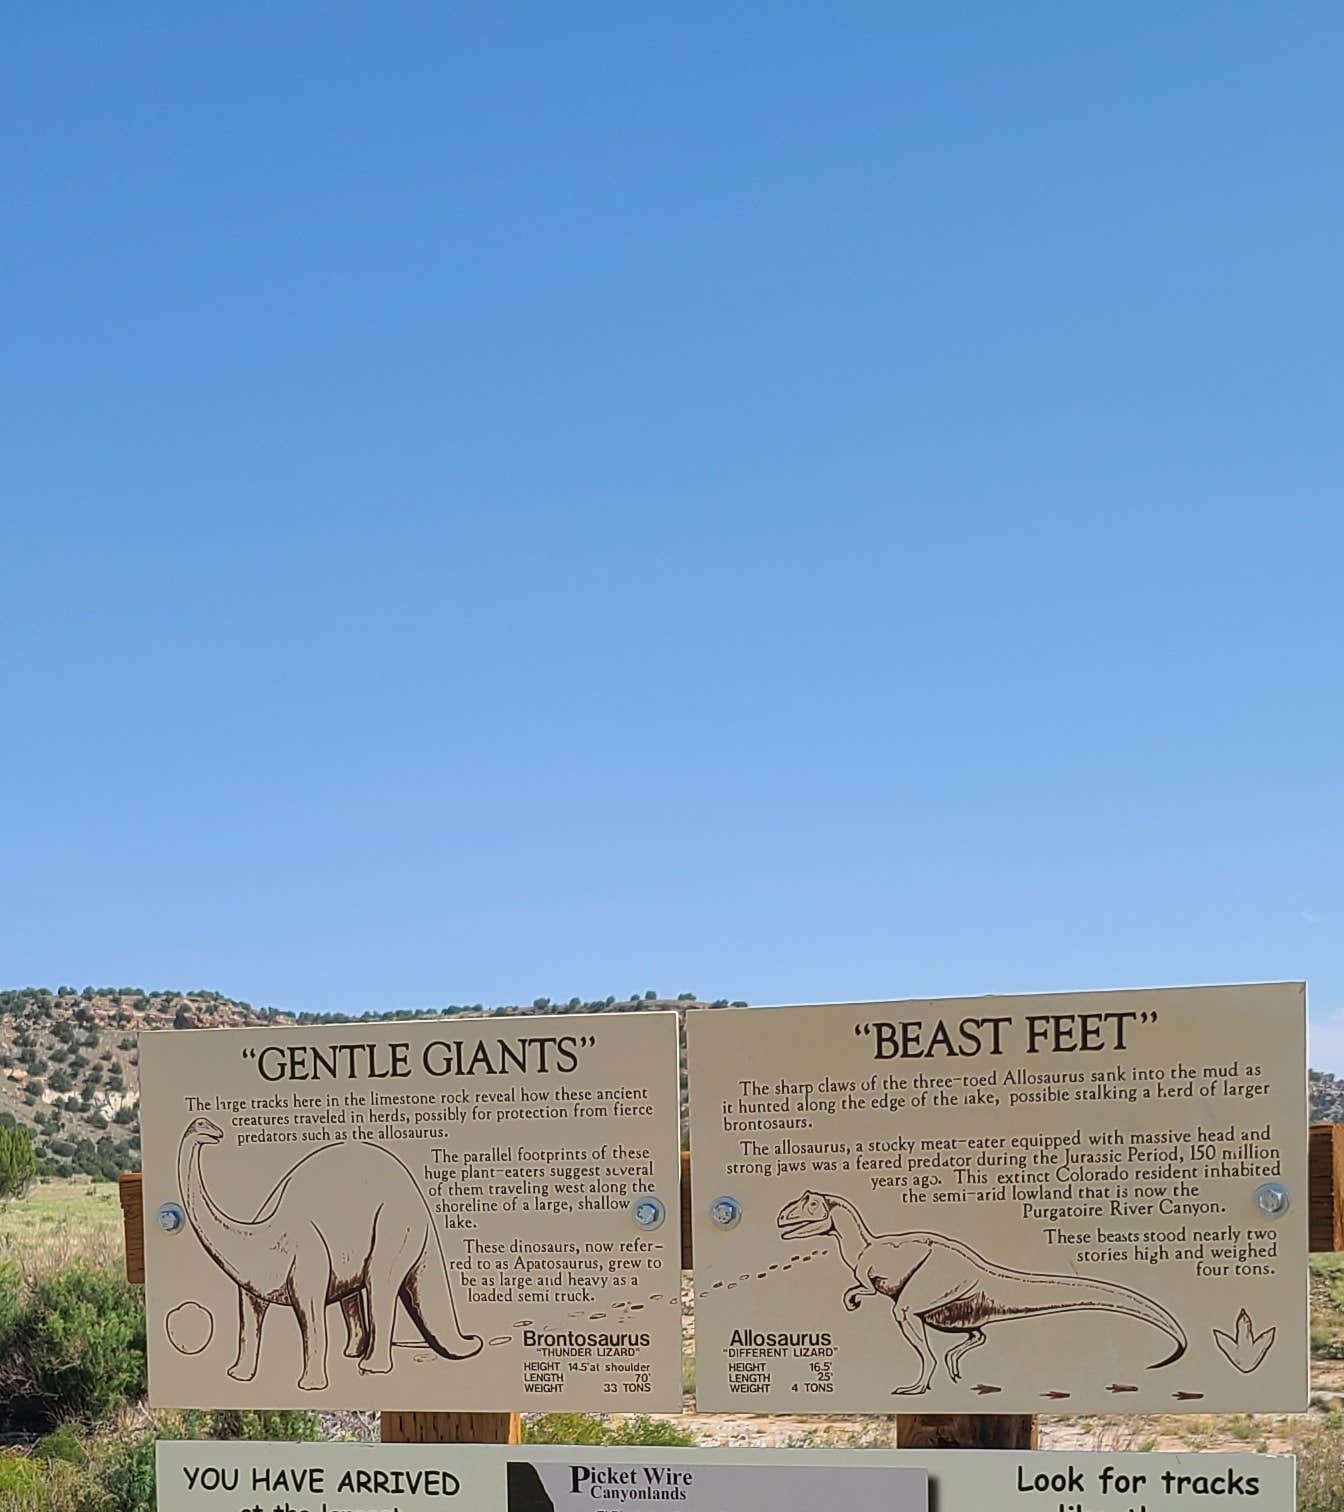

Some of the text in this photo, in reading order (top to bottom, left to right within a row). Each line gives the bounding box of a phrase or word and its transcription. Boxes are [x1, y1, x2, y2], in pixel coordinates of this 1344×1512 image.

[231, 1101, 653, 1126] creatures traveled in herds, possibly for protection from fierce
[723, 1116, 812, 1132] brontosaurs.
[237, 1125, 448, 1147] predators such as the allosaurus.
[430, 1145, 650, 1166] The parallel footprints of these
[902, 1181, 1199, 1203] the semi-arid lowland that is now the
[435, 1195, 631, 1214] shoreline of a large, shallow
[1022, 1198, 1226, 1222] Purgatoire River Canyon.
[444, 1214, 477, 1229] lake.
[1042, 1225, 1277, 1244] These beasts stood nearly two
[1196, 1261, 1275, 1276] four tons.
[523, 1330, 650, 1347] Brontosaurus
[729, 1329, 831, 1347] Allosaurus
[728, 1372, 833, 1383] LENGTH 25'
[523, 1383, 651, 1393] WEIGHT 33 TONS
[729, 1383, 834, 1393] WEIGHT 4 TONS
[182, 1467, 460, 1496] YOU HAVE ARRIVED
[568, 1465, 693, 1493] Picket Wire
[1017, 1465, 1259, 1496] Look for tracks
[590, 1485, 686, 1503] Canyonlands
